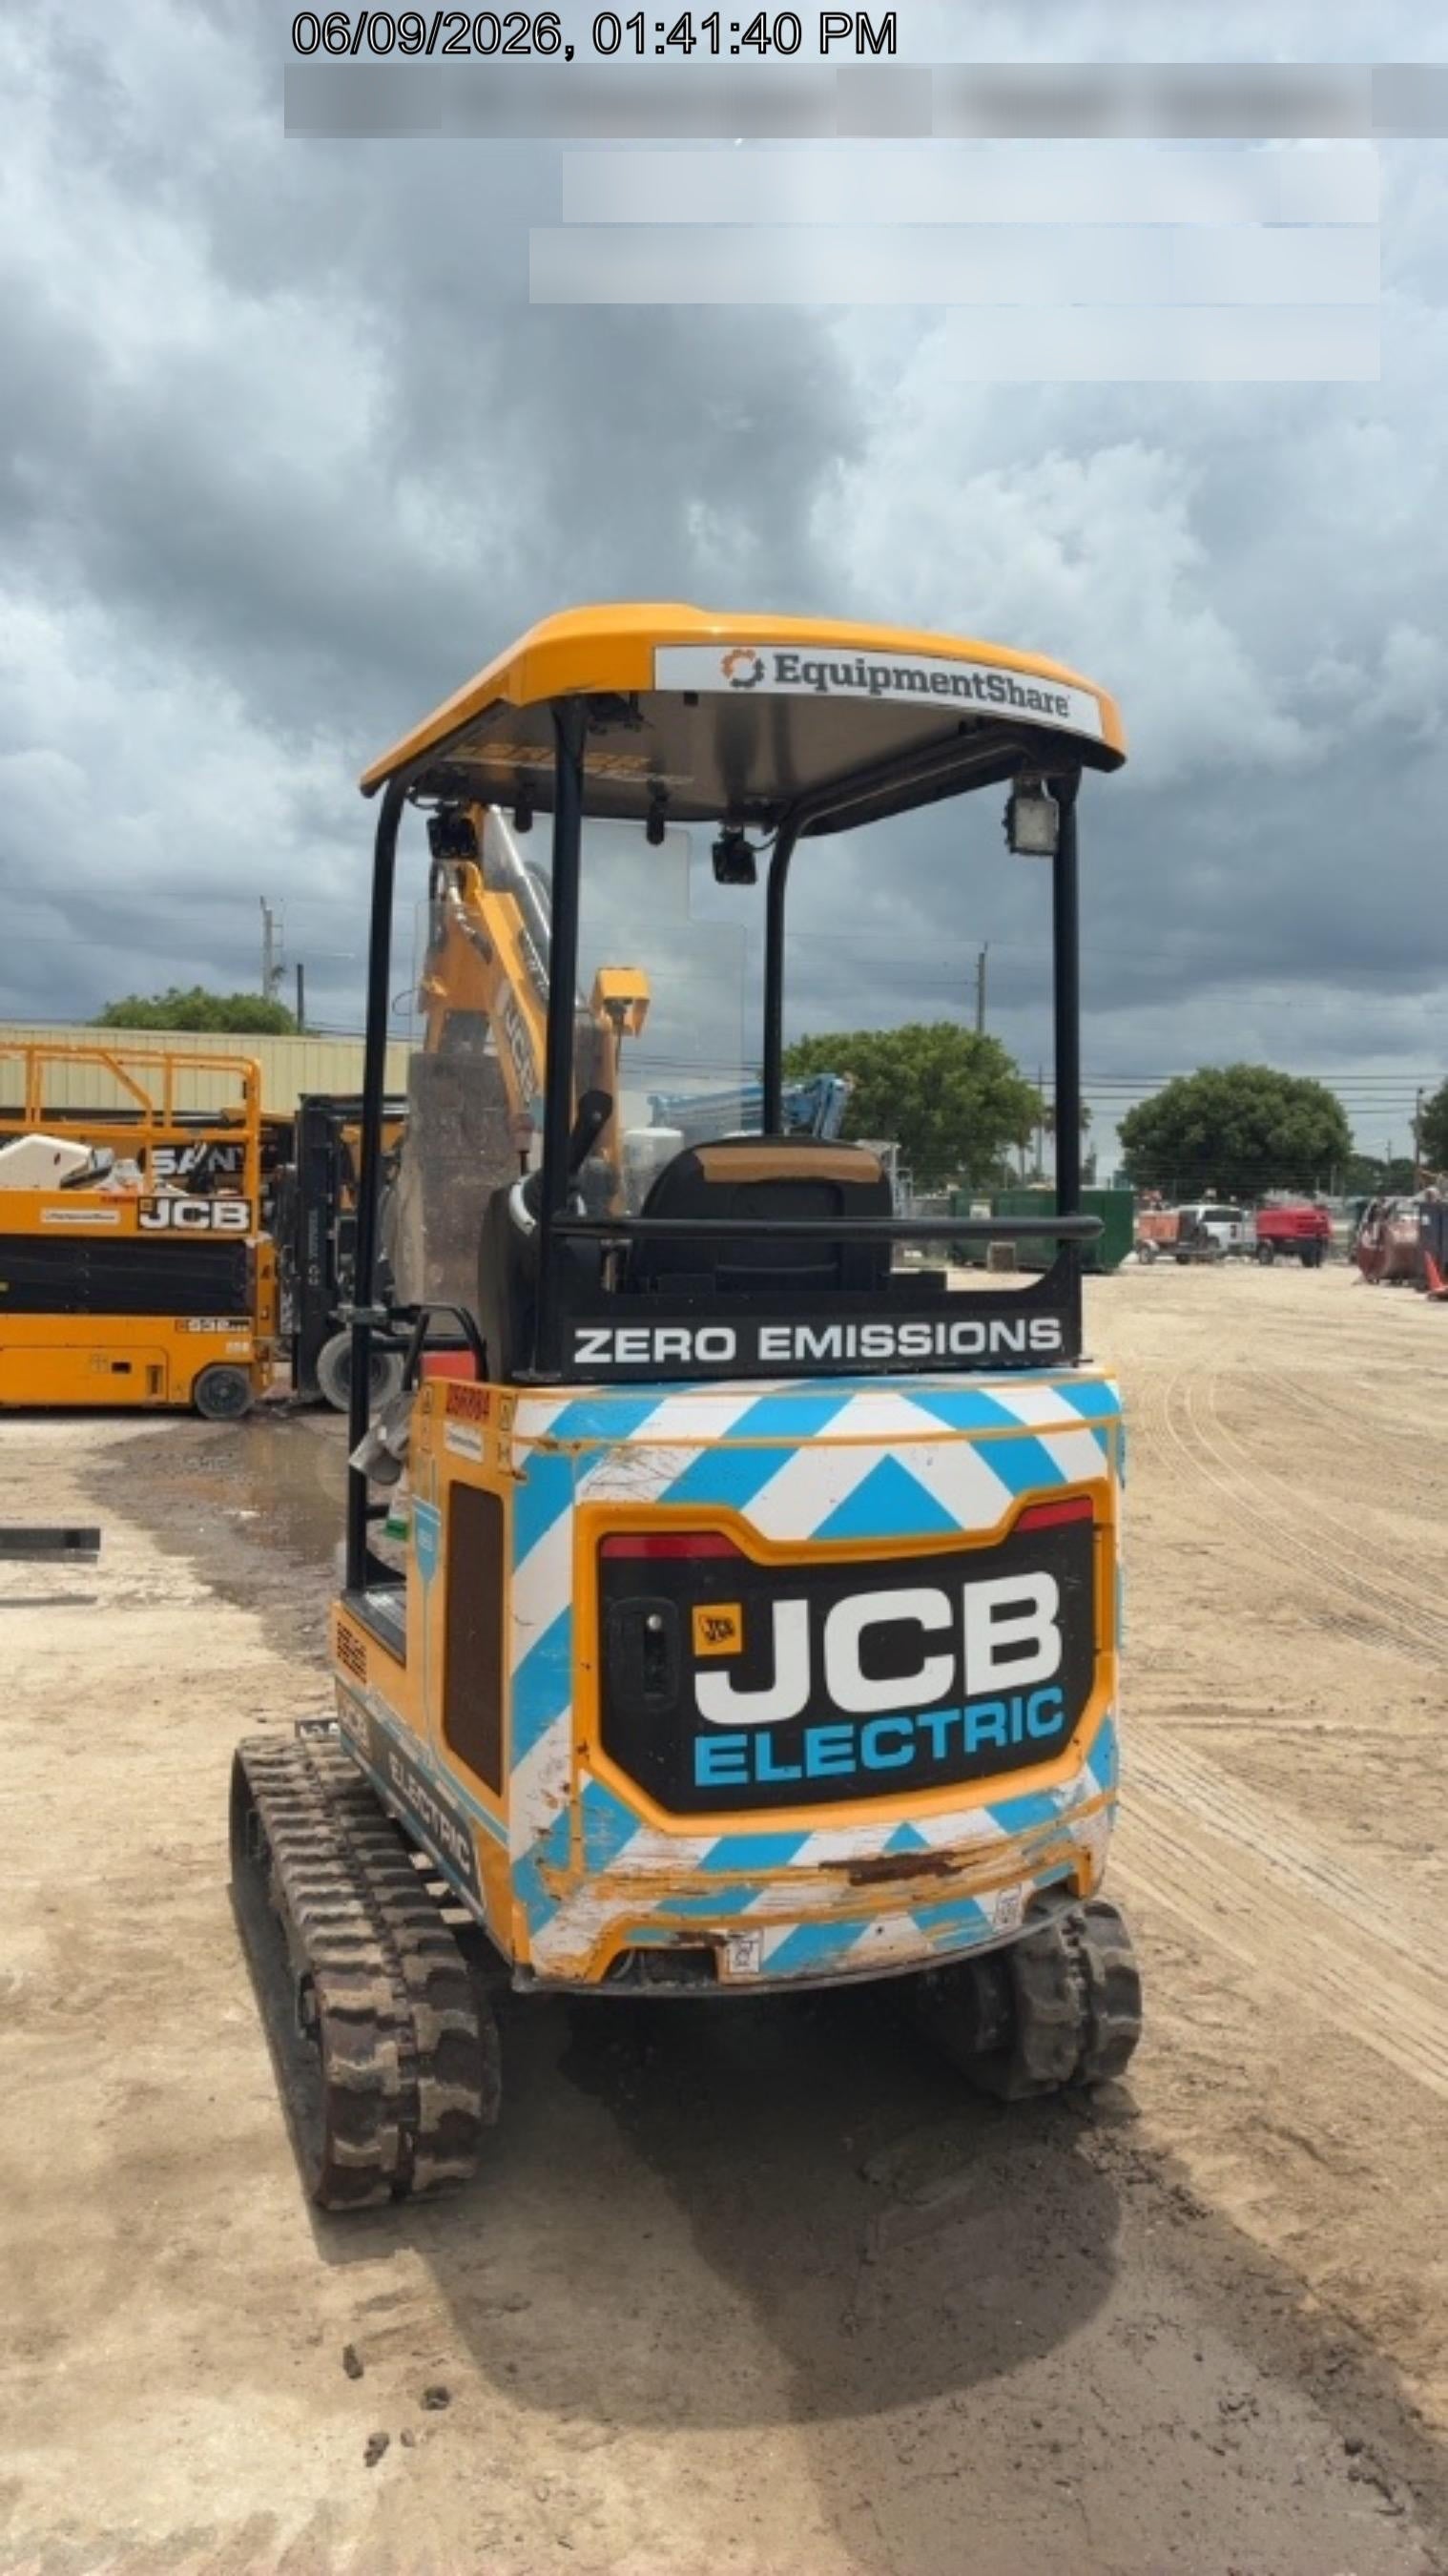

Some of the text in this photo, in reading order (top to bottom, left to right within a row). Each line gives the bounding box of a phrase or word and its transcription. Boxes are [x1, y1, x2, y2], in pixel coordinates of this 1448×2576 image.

[773, 653, 1070, 717] EquipmentShare
[139, 1197, 249, 1230] JCB
[573, 1317, 1064, 1364] ZERO EMISSIONS
[693, 1570, 1064, 1725] JCB
[694, 1686, 1065, 1787] ELECTRIC
